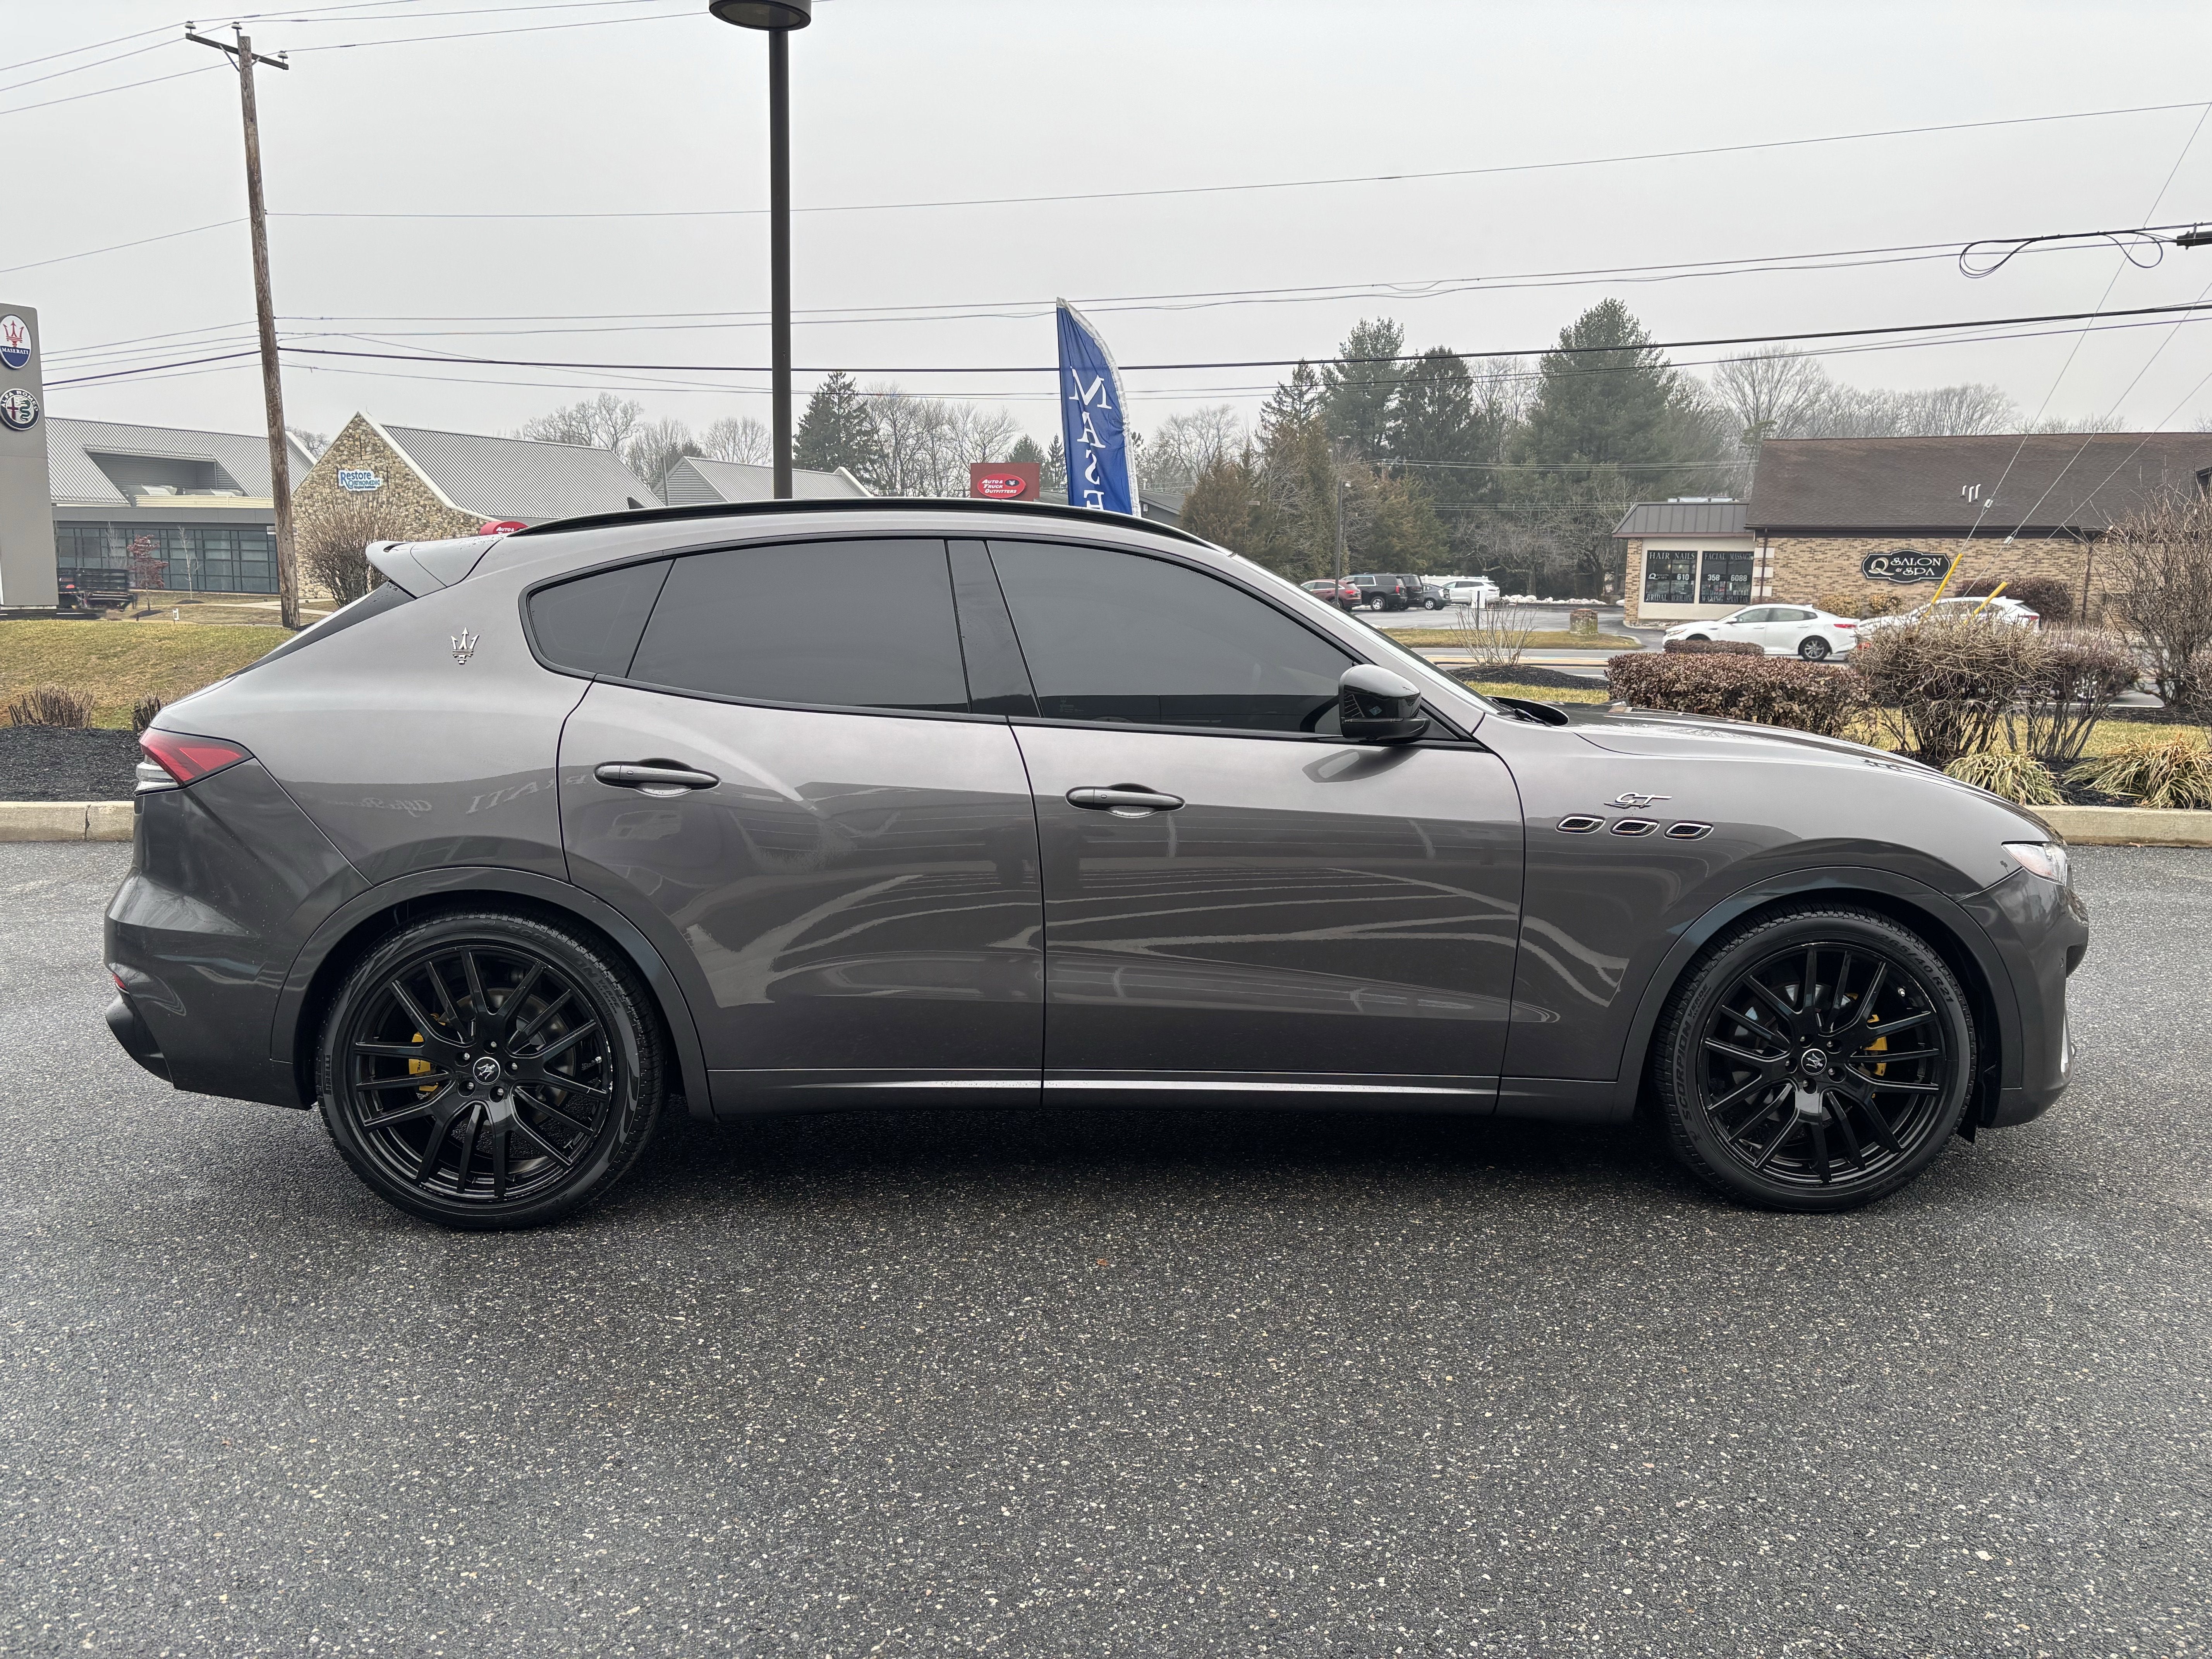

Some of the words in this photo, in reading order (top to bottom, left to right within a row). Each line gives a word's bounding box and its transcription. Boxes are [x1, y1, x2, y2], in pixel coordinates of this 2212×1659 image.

[1, 392, 14, 408] ALFA
[16, 390, 38, 411] ROMEO
[340, 471, 371, 485] Restore
[1868, 557, 1895, 575] Q
[1890, 557, 1942, 566] SALON
[1903, 567, 1935, 575] SPA
[1604, 792, 1673, 809] GT
[1878, 934, 1934, 972] 265/40
[1932, 977, 1954, 1002] R21
[598, 979, 619, 1006] VERDE
[1676, 1020, 1692, 1122] SCORPION
[1687, 983, 1707, 1018] VERDE
